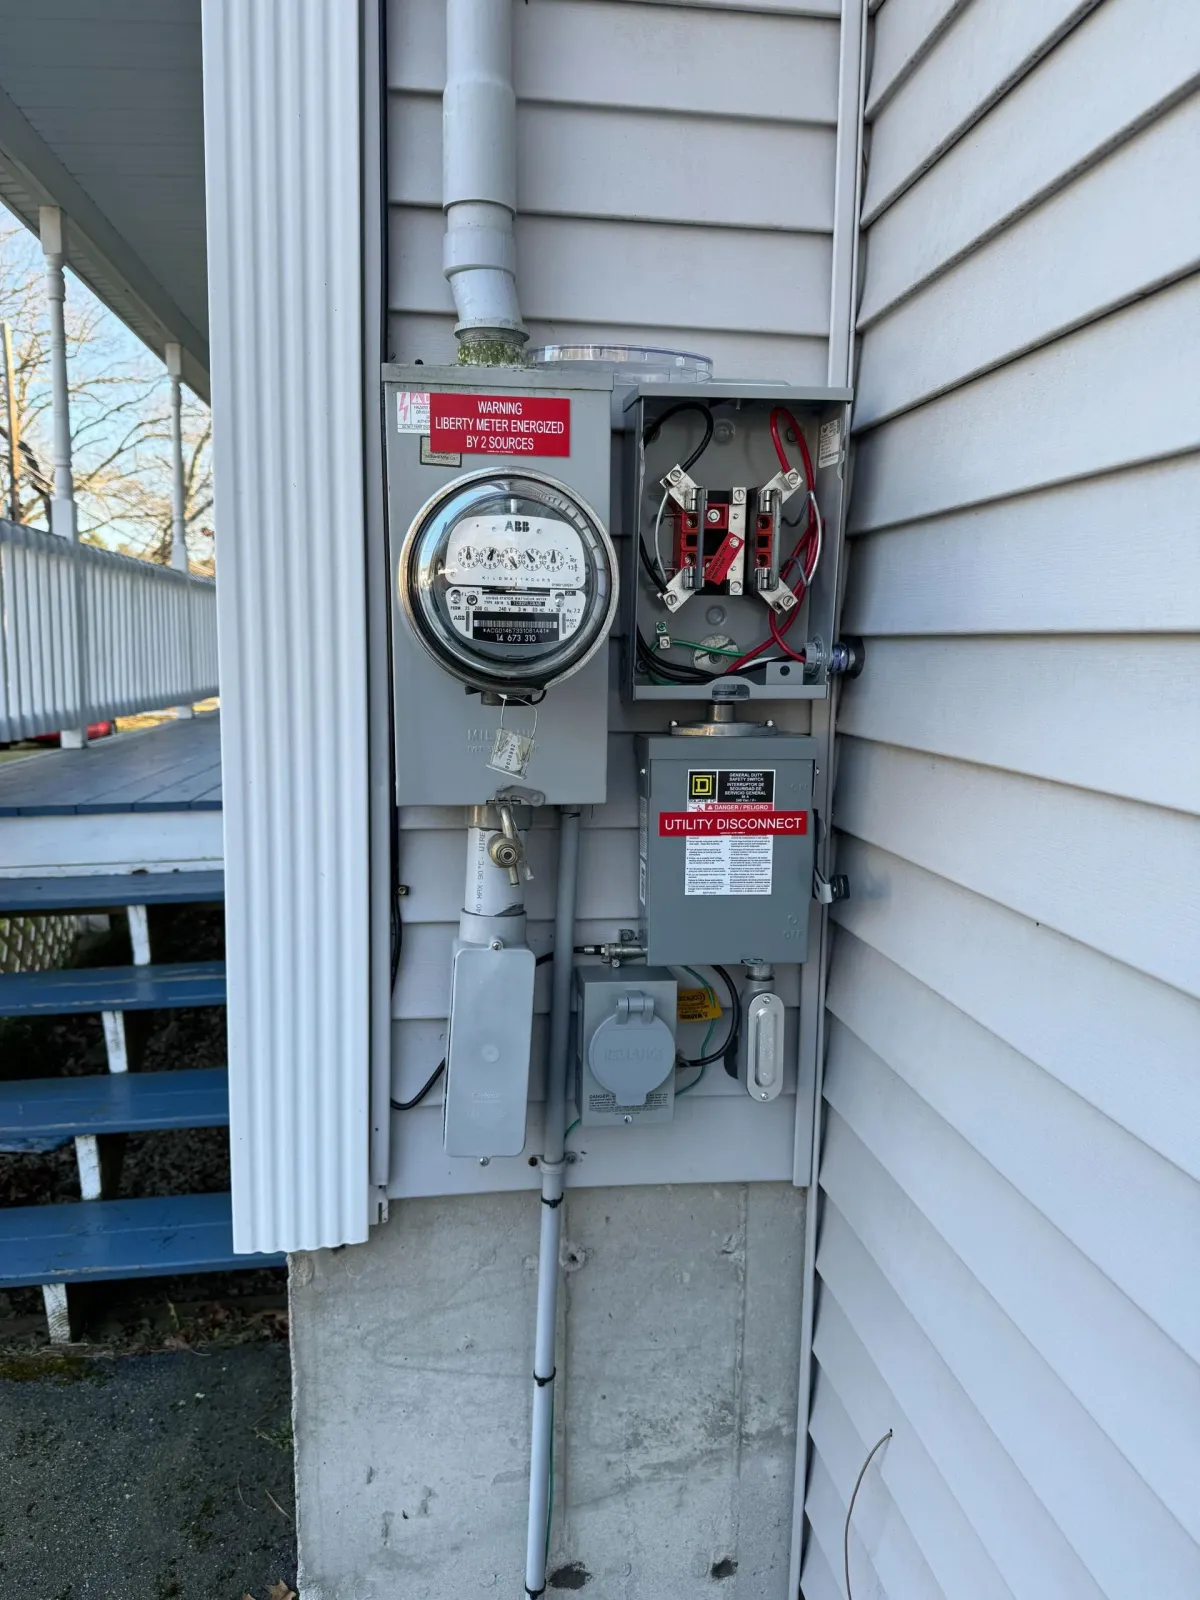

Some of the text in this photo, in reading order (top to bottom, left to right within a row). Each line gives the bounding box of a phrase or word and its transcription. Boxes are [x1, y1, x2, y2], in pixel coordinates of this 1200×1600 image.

[477, 401, 522, 415] WARNING
[435, 417, 564, 434] LIBERTY METER ENERGIZED
[466, 436, 534, 450] BY 2 SOURCES
[504, 520, 530, 532] ABB
[496, 634, 536, 642] 14 673 310
[664, 817, 802, 831] UTILITY DISCONNECT
[478, 831, 486, 852] WIRE
[476, 903, 482, 914] 40
